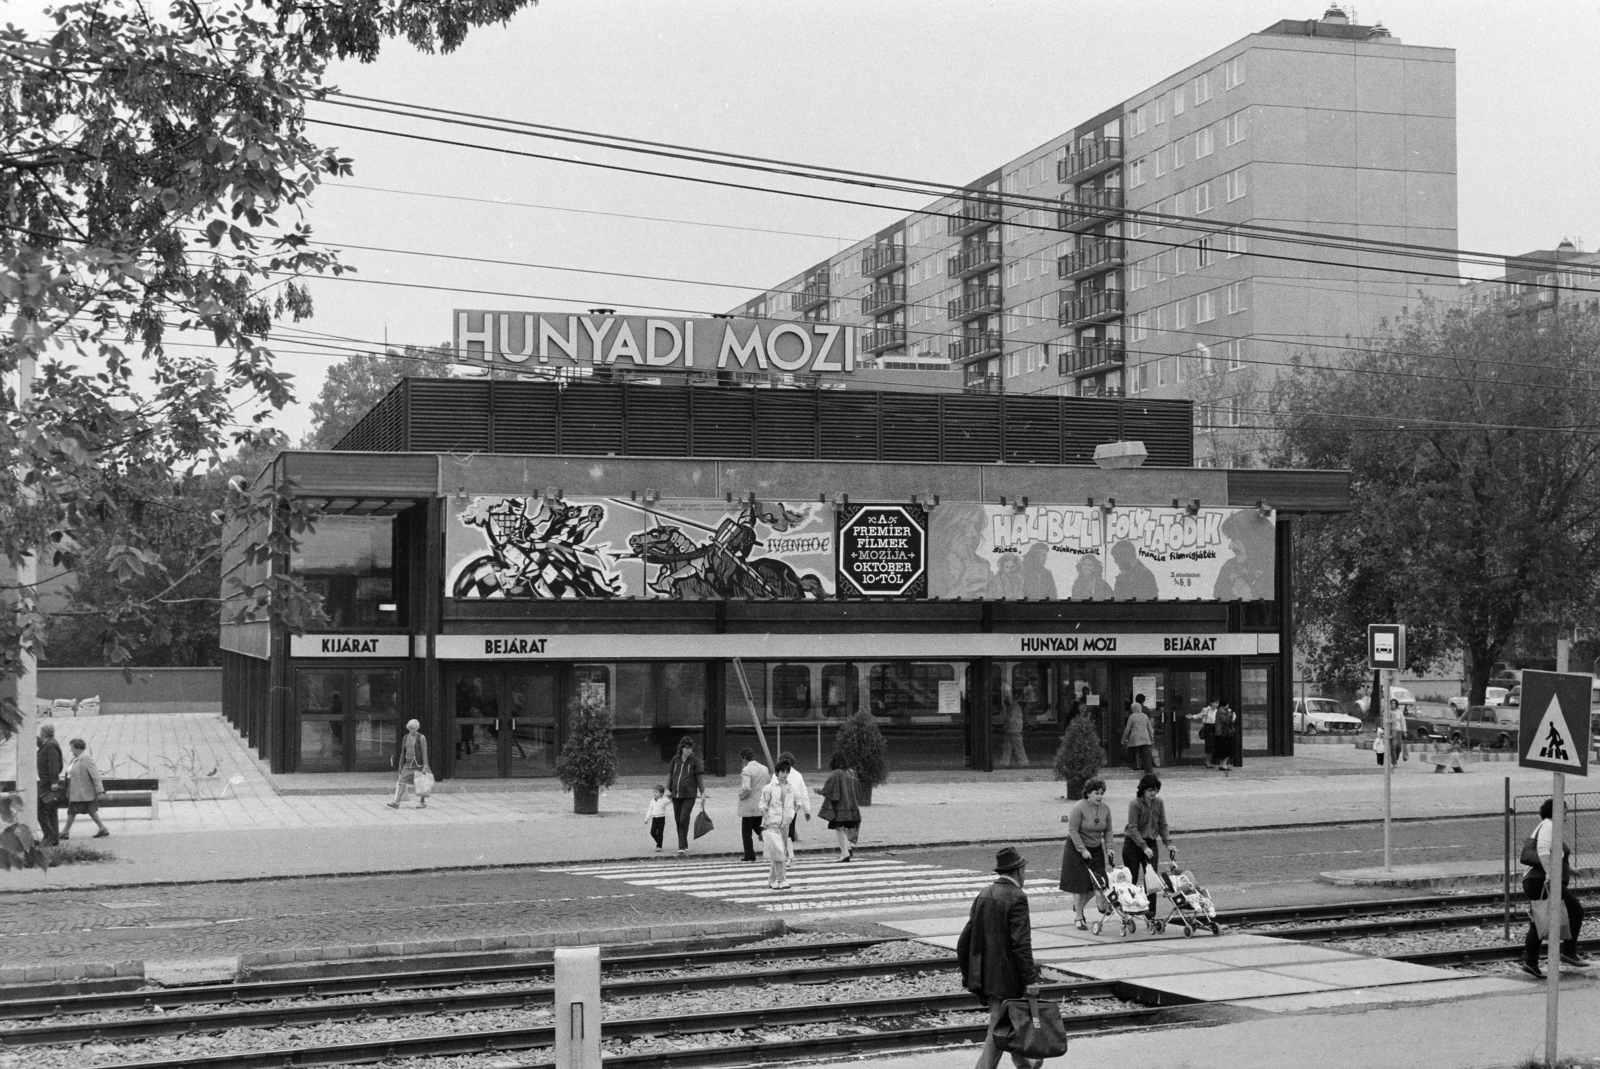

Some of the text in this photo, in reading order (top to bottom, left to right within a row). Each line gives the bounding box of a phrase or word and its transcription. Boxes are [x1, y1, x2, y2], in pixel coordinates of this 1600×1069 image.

[458, 312, 854, 372] HUNYADI MOZI
[877, 514, 888, 524] A
[767, 536, 830, 554] IVANHOE
[1139, 547, 1166, 562] francia
[853, 560, 912, 572] OKTÓBER
[322, 637, 379, 653] KIJÁRAT
[485, 637, 548, 654] BEJÁRAT
[1021, 638, 1117, 652] HUNYADI MOZI
[1164, 635, 1217, 651] BEJÁRAT
